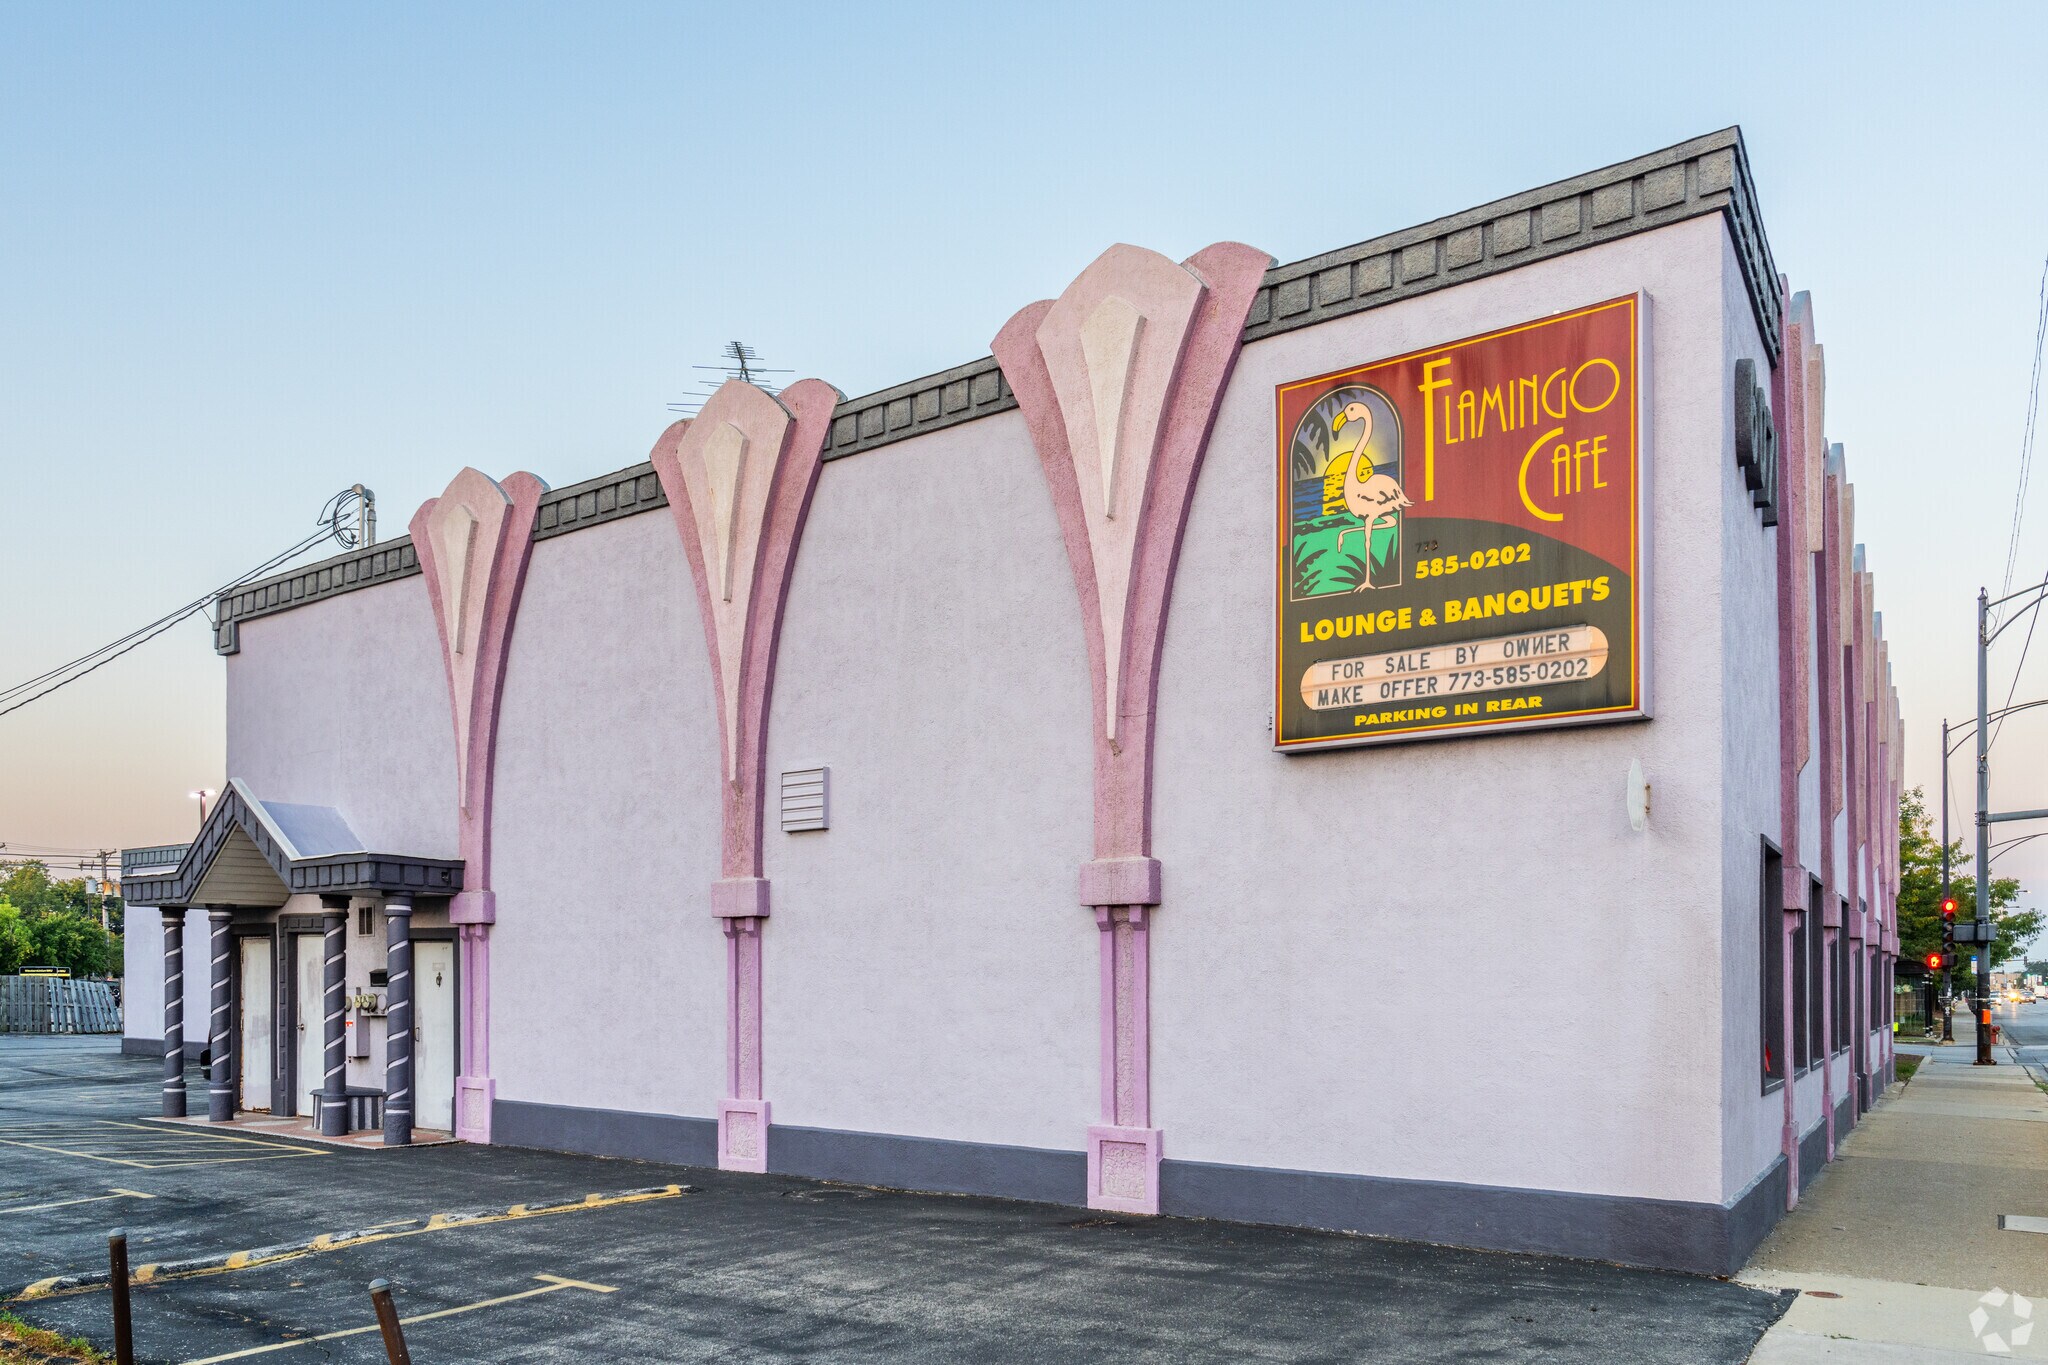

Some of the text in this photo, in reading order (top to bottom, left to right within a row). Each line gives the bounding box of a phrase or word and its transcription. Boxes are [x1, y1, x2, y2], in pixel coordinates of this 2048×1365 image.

[1418, 357, 1621, 501] FLAMINGO
[1518, 426, 1608, 522] CAFE
[1415, 542, 1531, 579] 585-0202
[1300, 576, 1610, 643] LOUNGE & BANQUET'S
[1331, 633, 1571, 681] FOR SALE BY OWNER
[1317, 658, 1588, 707] MAKE OFFER 773-585-0202
[1354, 696, 1543, 727] PARKING IN REAR
